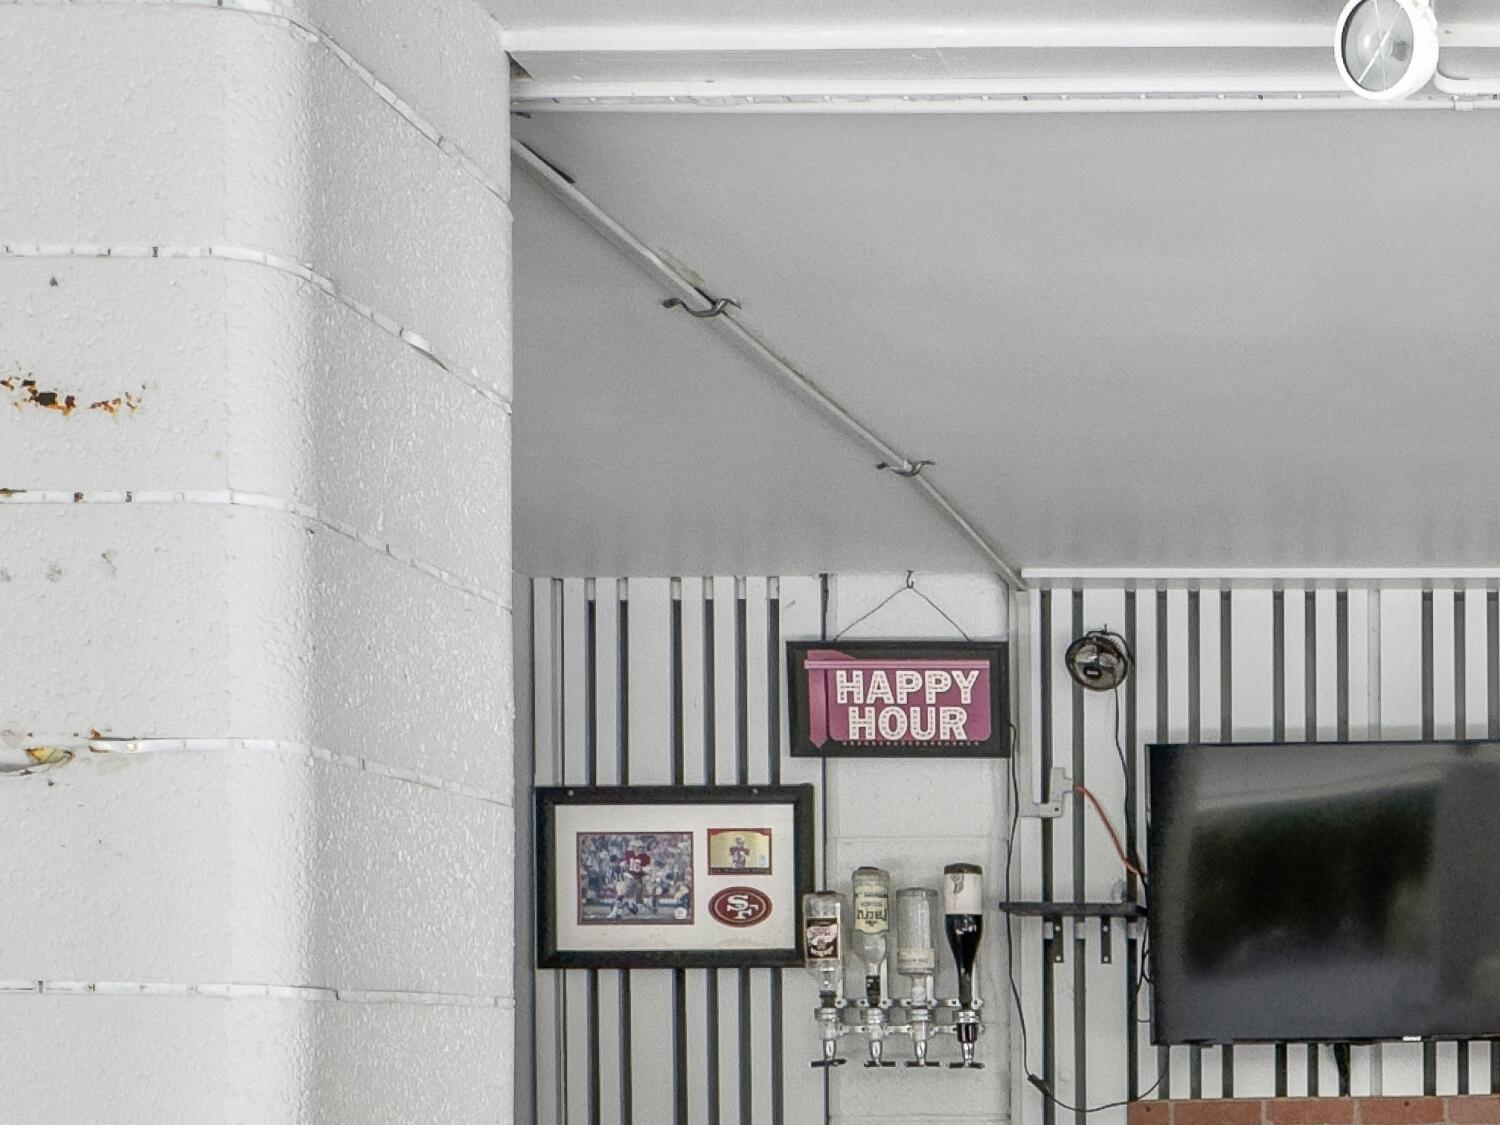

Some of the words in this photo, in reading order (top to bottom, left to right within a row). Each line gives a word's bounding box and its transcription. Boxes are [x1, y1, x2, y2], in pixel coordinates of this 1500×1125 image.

[836, 670, 980, 704] HAPPY
[848, 706, 968, 740] HOUR
[726, 894, 760, 920] SF
